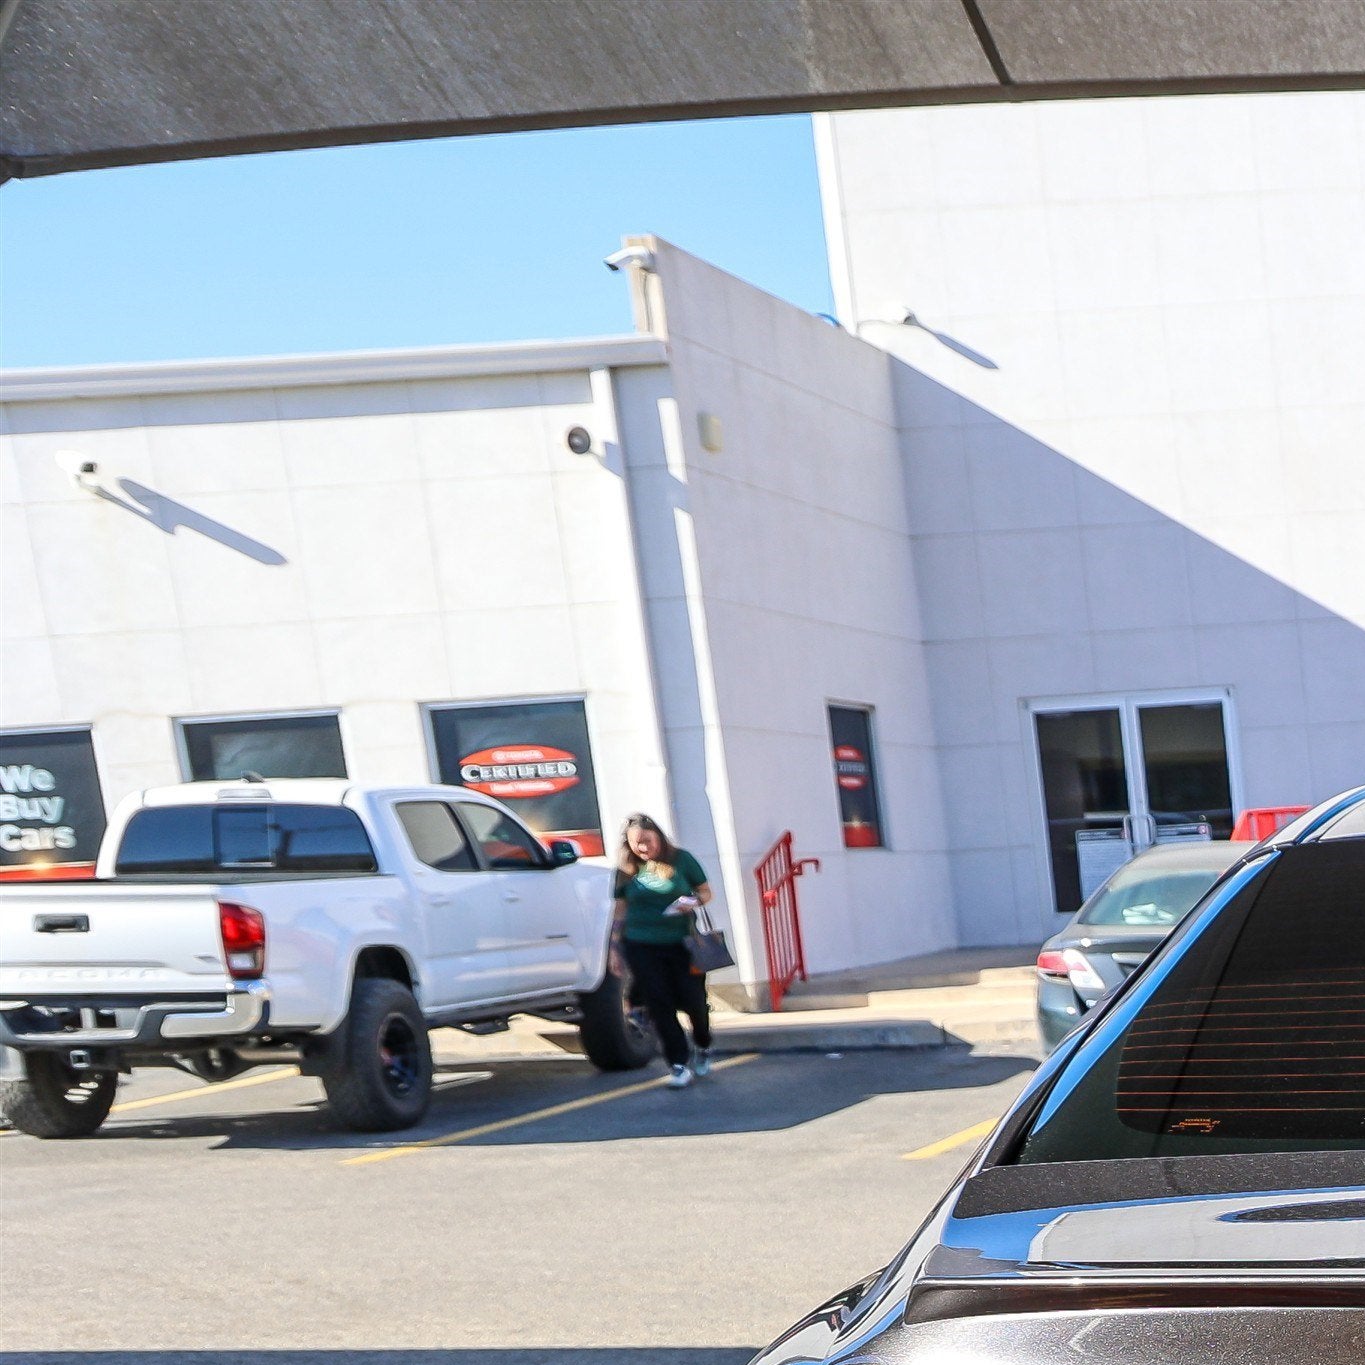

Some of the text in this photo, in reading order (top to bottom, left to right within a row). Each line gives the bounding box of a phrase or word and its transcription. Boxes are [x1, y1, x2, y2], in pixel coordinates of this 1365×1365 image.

[0, 764, 55, 793] We
[0, 794, 65, 824] Buy
[0, 824, 77, 852] Cars
